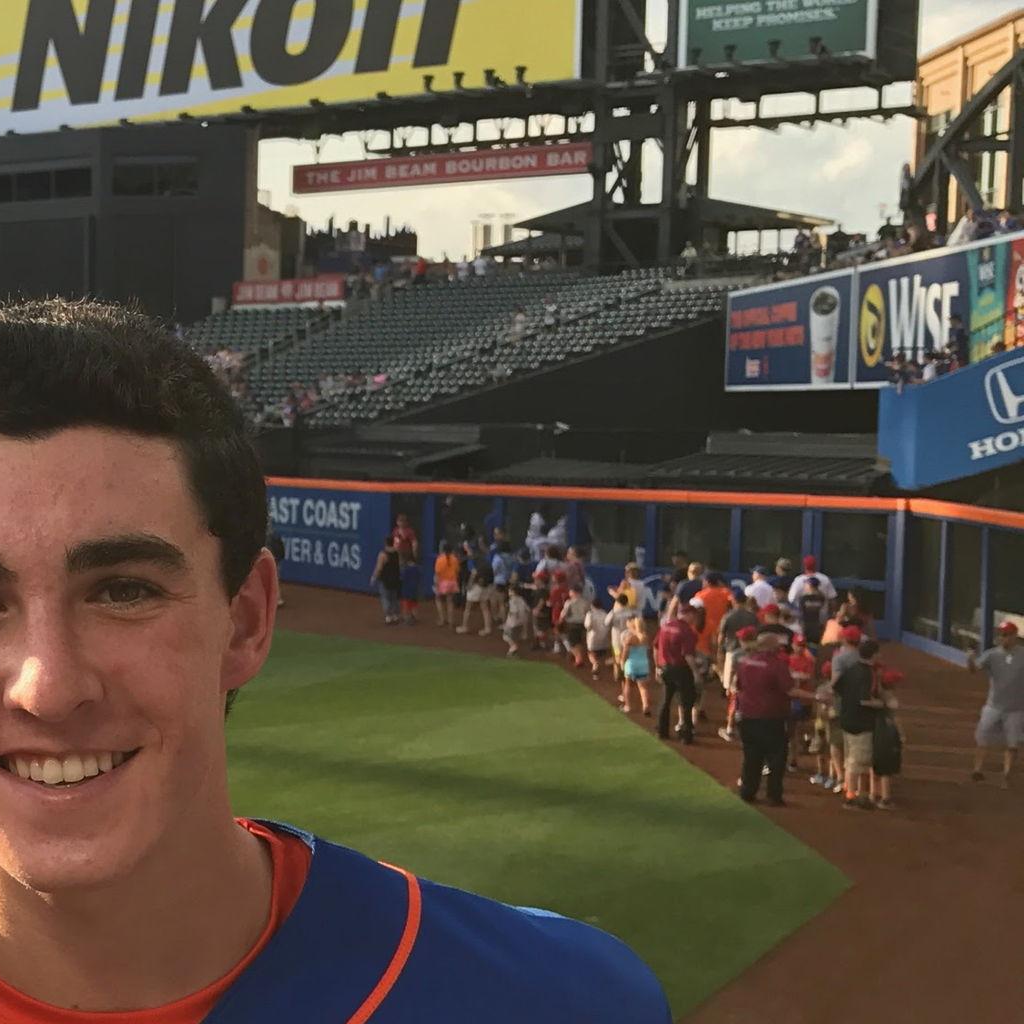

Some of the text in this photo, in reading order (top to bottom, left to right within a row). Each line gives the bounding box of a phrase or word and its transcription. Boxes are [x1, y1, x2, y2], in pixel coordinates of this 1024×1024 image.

[306, 150, 588, 185] THE JIM BEAM BOURBON BAR
[302, 498, 362, 530] COAST
[313, 541, 325, 566] &
[327, 541, 362, 570] GAS
